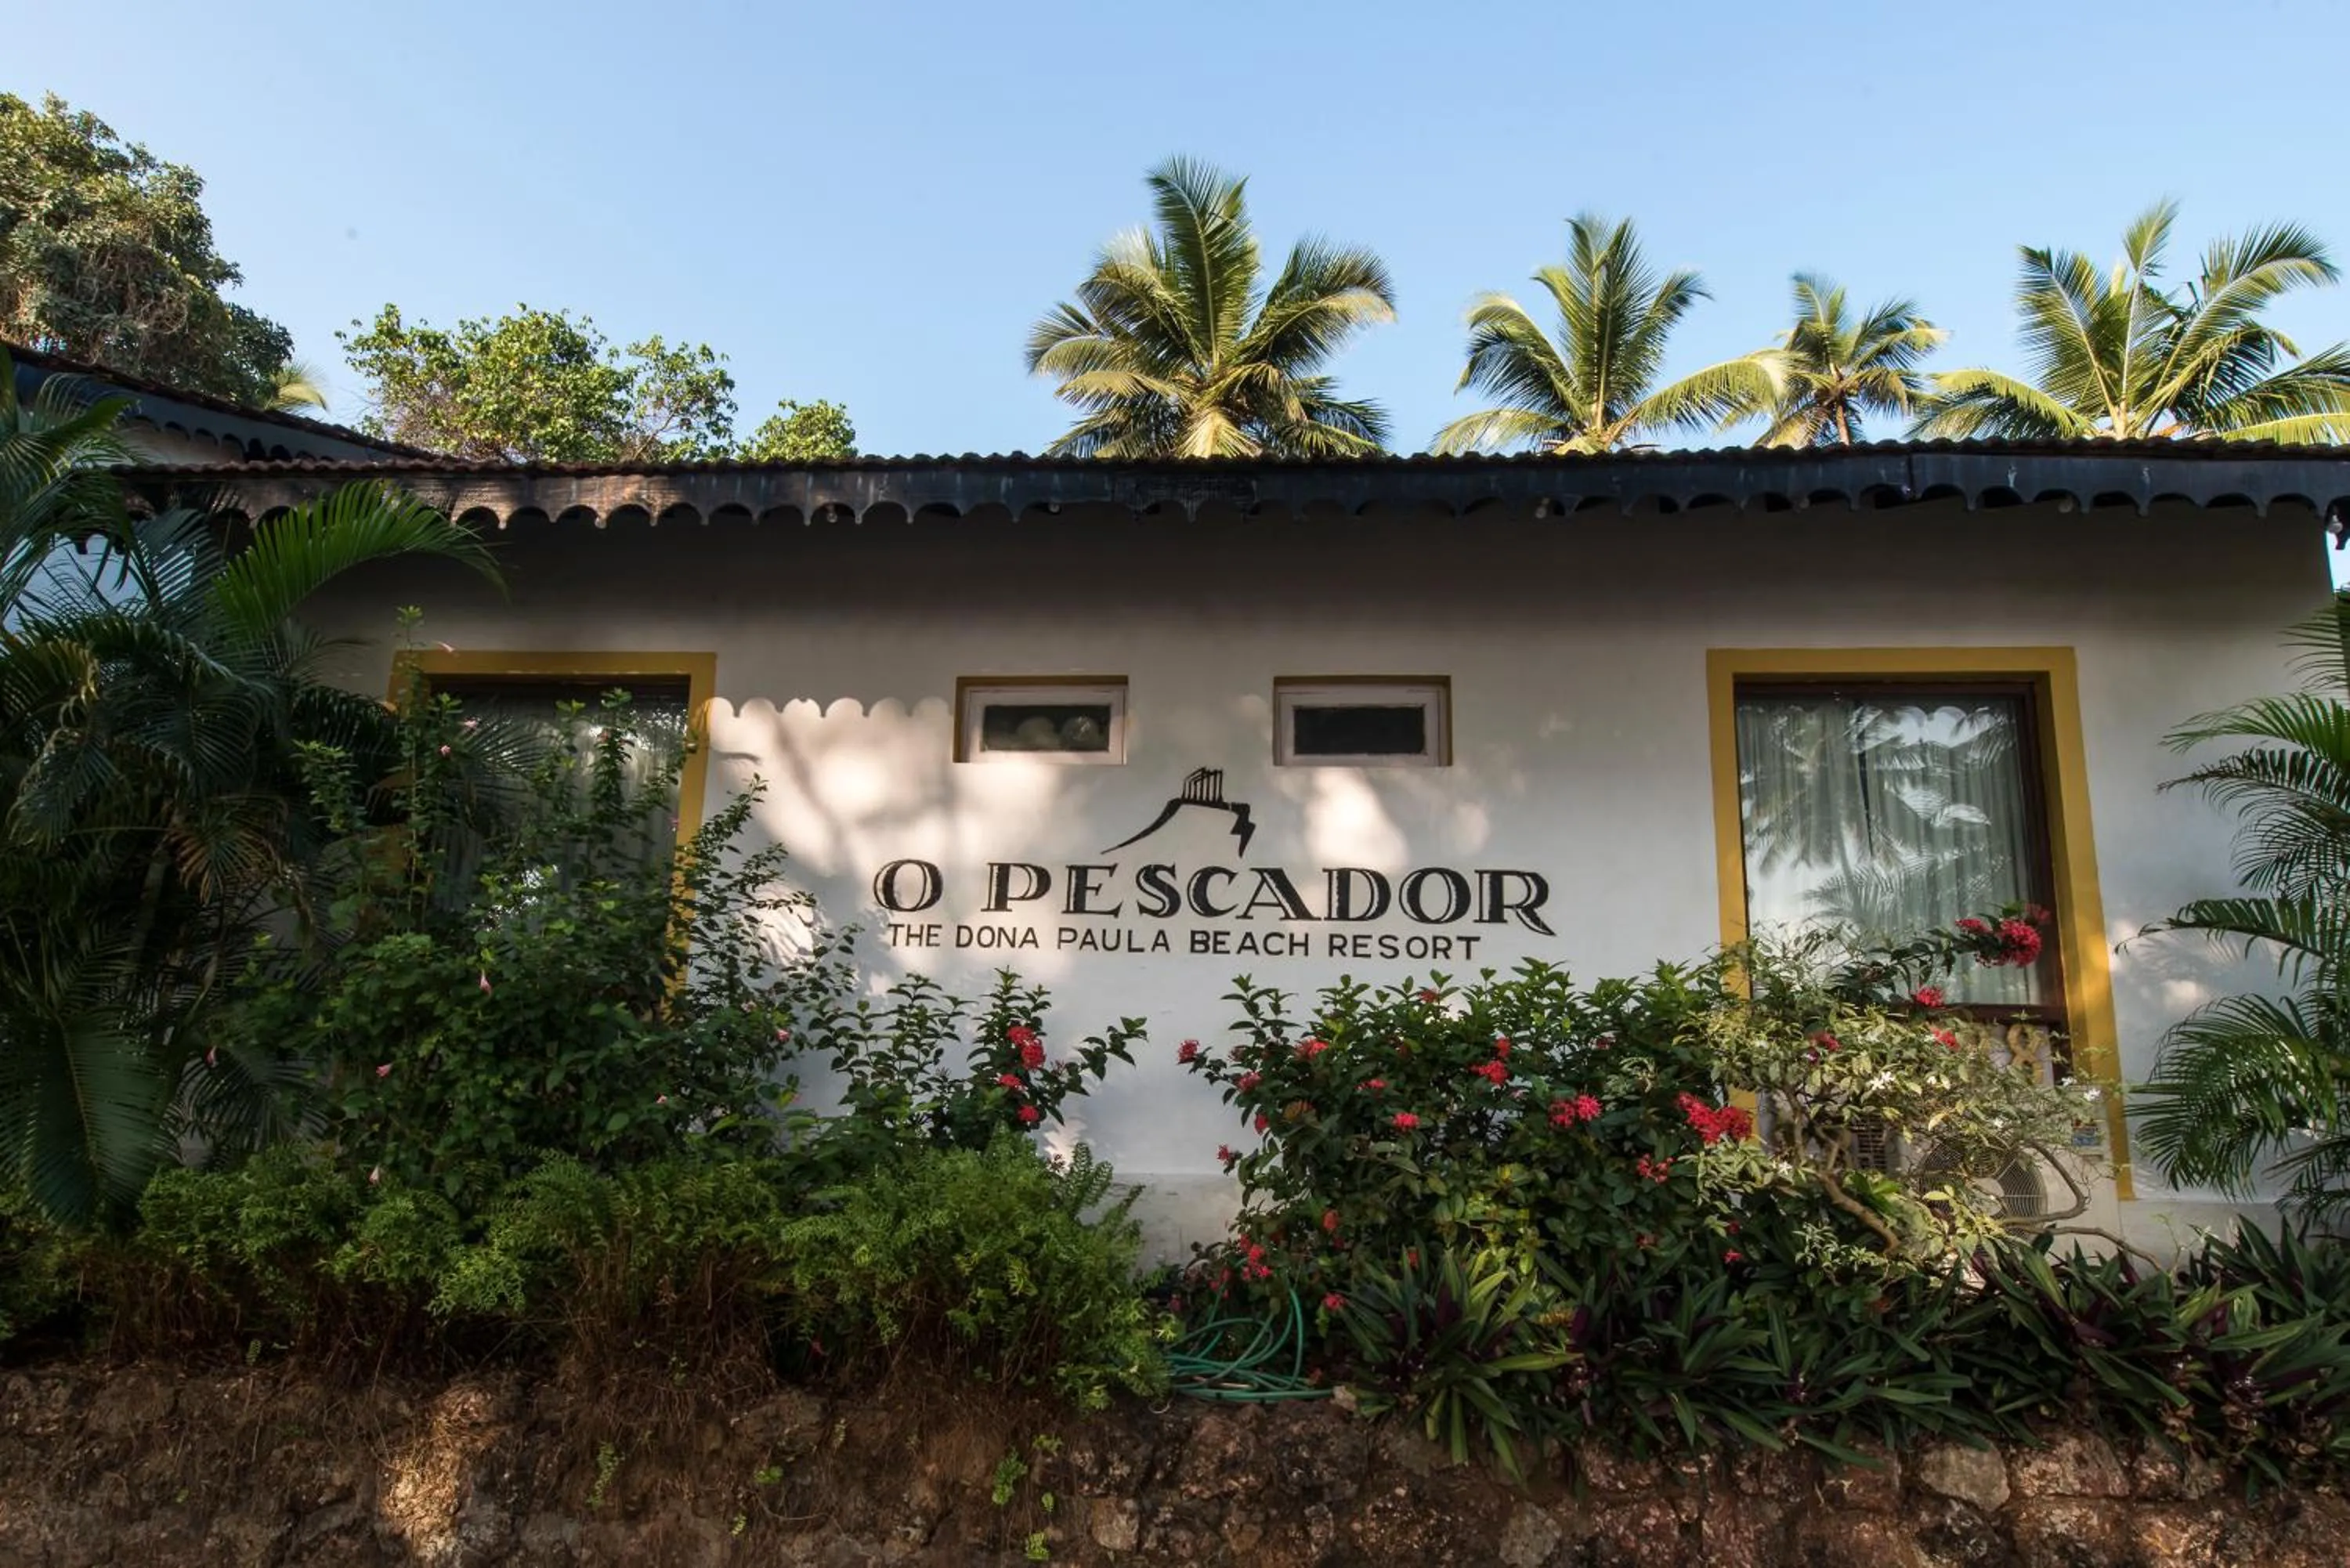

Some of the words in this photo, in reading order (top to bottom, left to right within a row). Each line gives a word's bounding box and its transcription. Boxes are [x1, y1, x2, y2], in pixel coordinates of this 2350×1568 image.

[873, 859, 943, 913] O
[981, 862, 1556, 937] PESCADOR
[888, 923, 942, 948] THE
[956, 924, 1039, 949] DONA
[1058, 927, 1170, 953] PAULA
[1190, 930, 1309, 957] BEACH
[1329, 933, 1481, 961] RESORT
